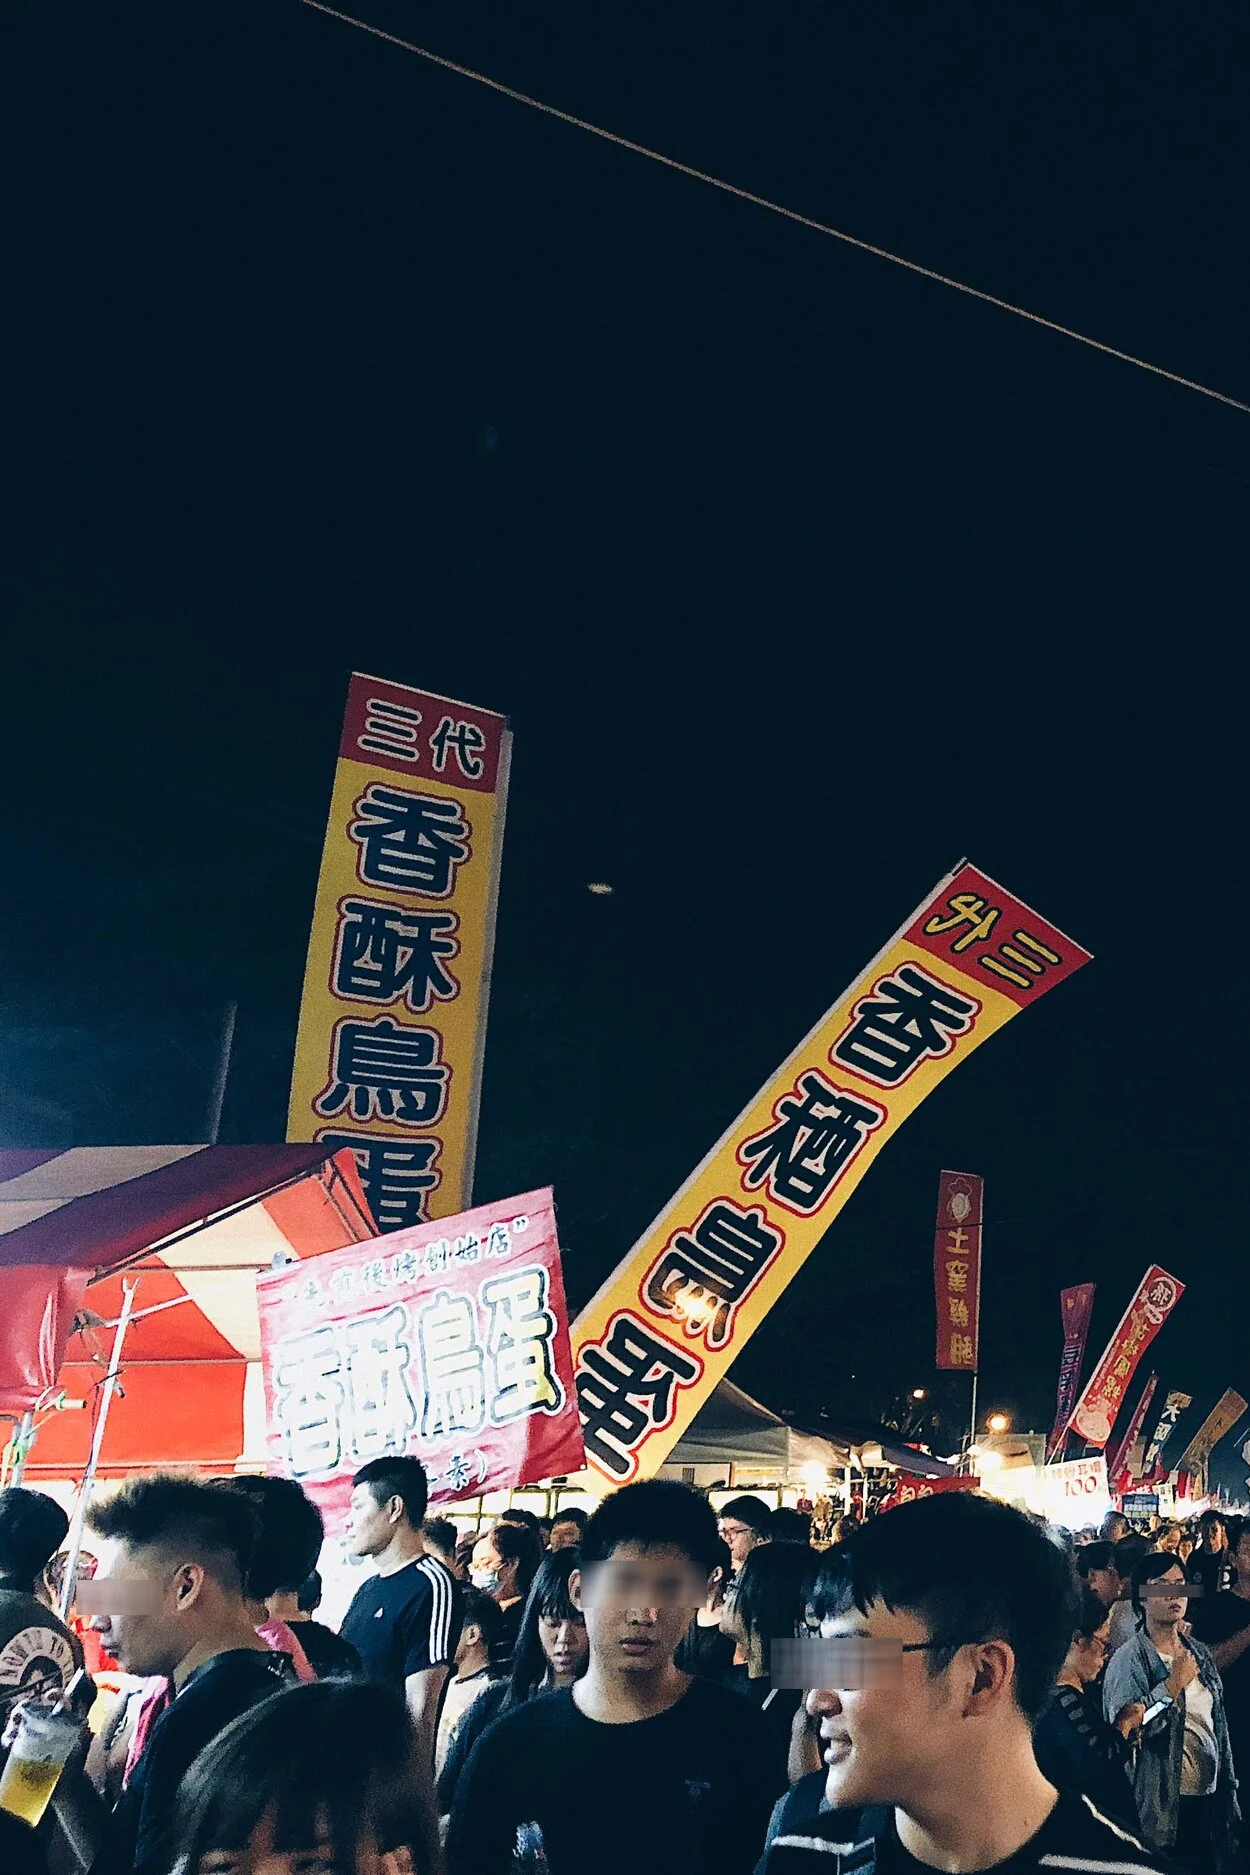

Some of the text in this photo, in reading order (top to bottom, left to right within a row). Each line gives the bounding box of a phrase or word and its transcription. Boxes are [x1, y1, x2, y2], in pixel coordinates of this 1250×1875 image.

[357, 697, 487, 779] 三代
[310, 781, 472, 1230] 香酥鳥蛋
[1064, 1475, 1097, 1497] 100
